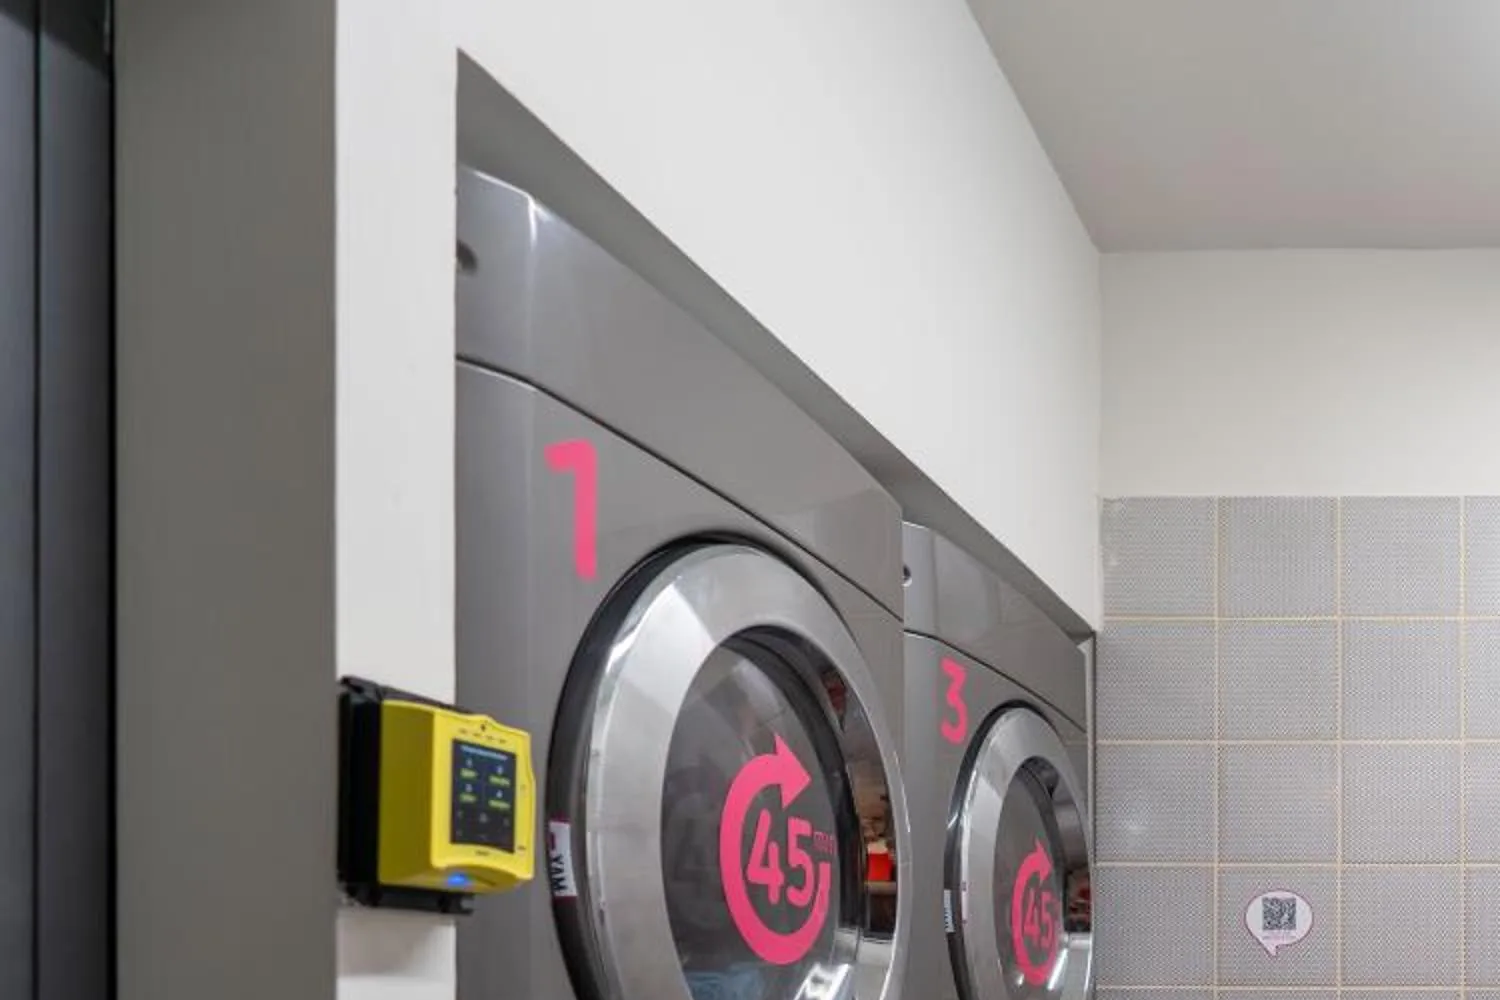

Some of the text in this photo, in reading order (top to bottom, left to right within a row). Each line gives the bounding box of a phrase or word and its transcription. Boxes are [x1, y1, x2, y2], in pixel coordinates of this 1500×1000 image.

[544, 439, 597, 581] 1
[940, 656, 968, 744] 3
[747, 808, 816, 907] 45
[1023, 887, 1055, 948] 45
